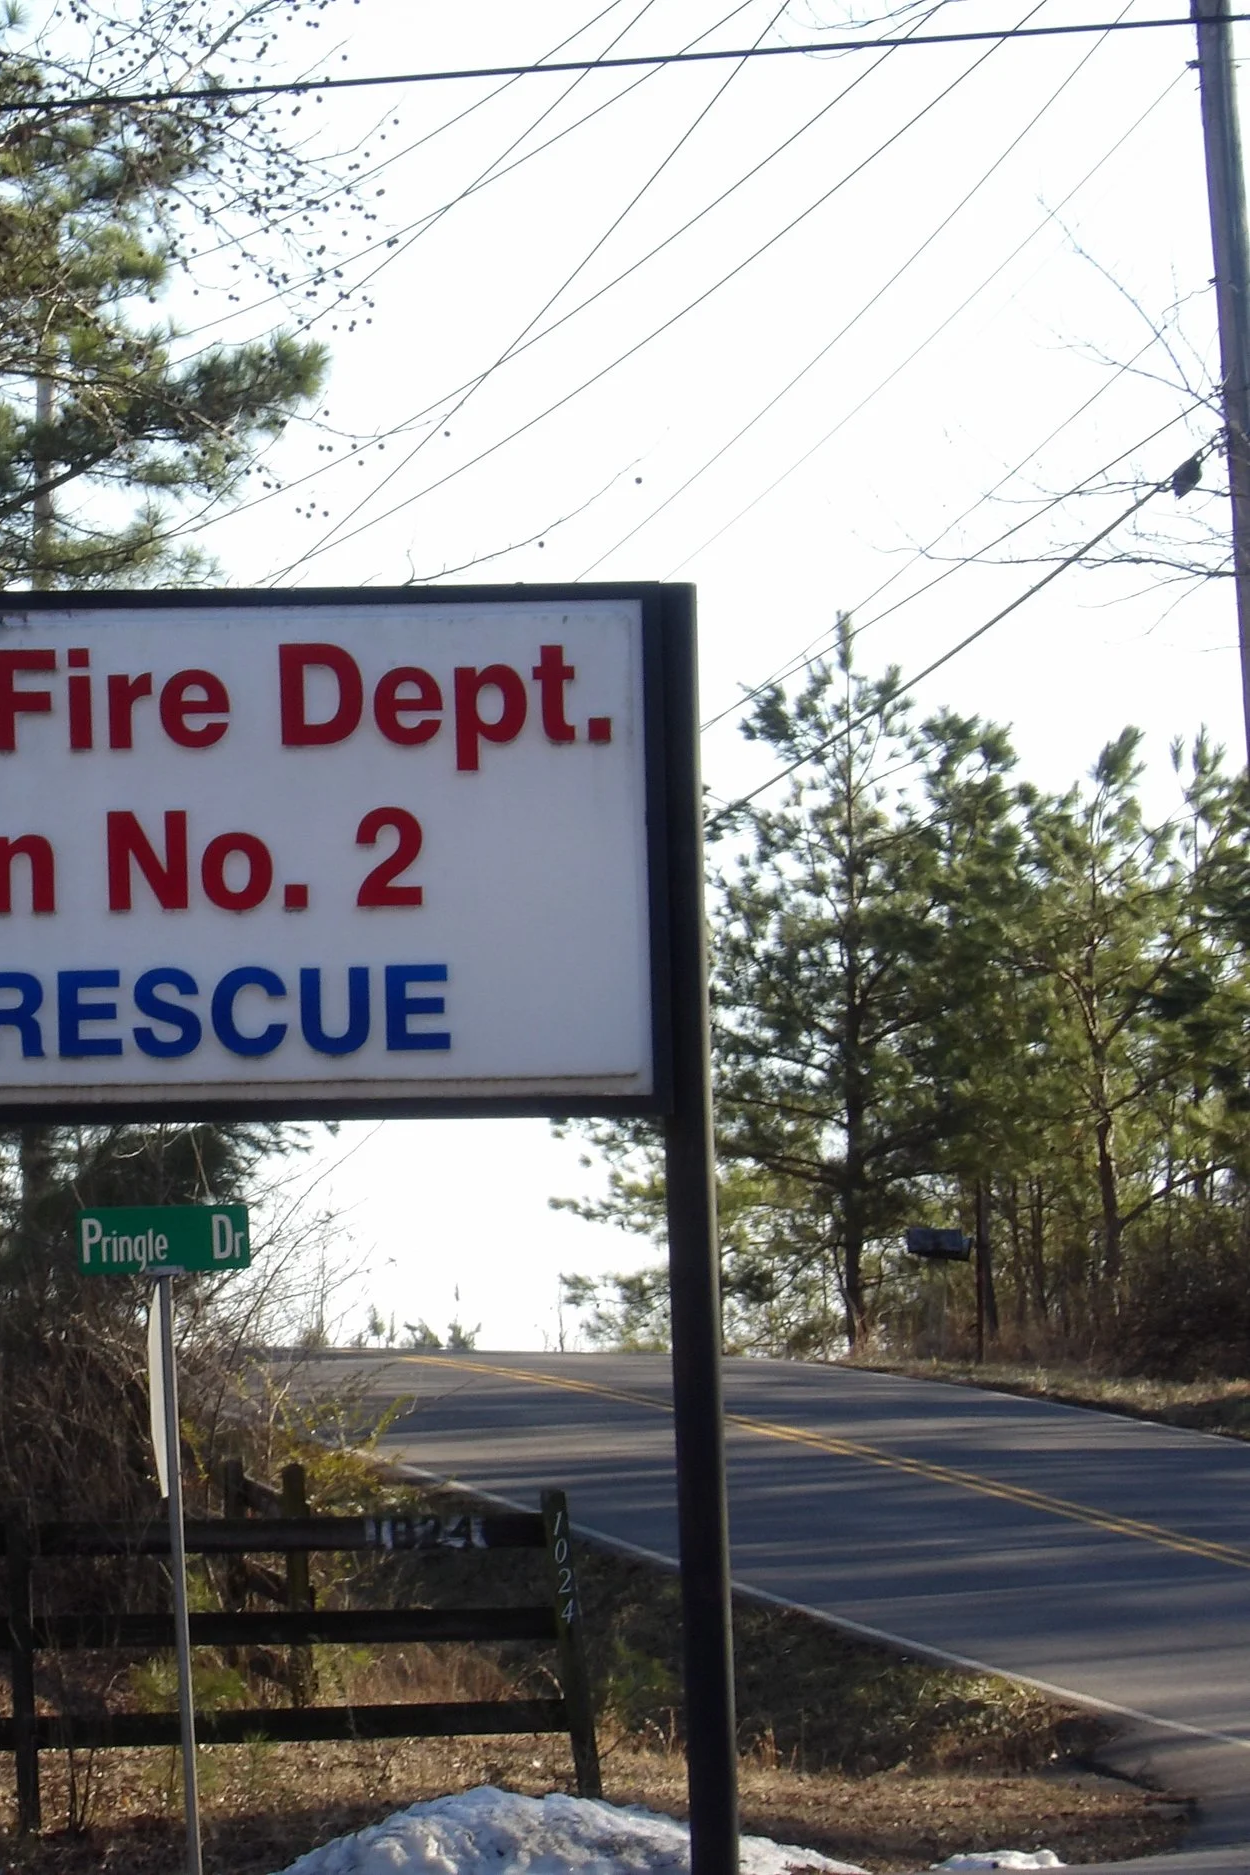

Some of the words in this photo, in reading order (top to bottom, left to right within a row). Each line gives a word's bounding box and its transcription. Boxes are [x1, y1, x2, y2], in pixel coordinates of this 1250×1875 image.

[278, 643, 612, 771] Dept.
[107, 810, 309, 911] No.
[355, 807, 424, 906] 2
[81, 1217, 169, 1272] Pringle
[211, 1213, 245, 1260] Dr
[554, 1510, 575, 1624] 1024
